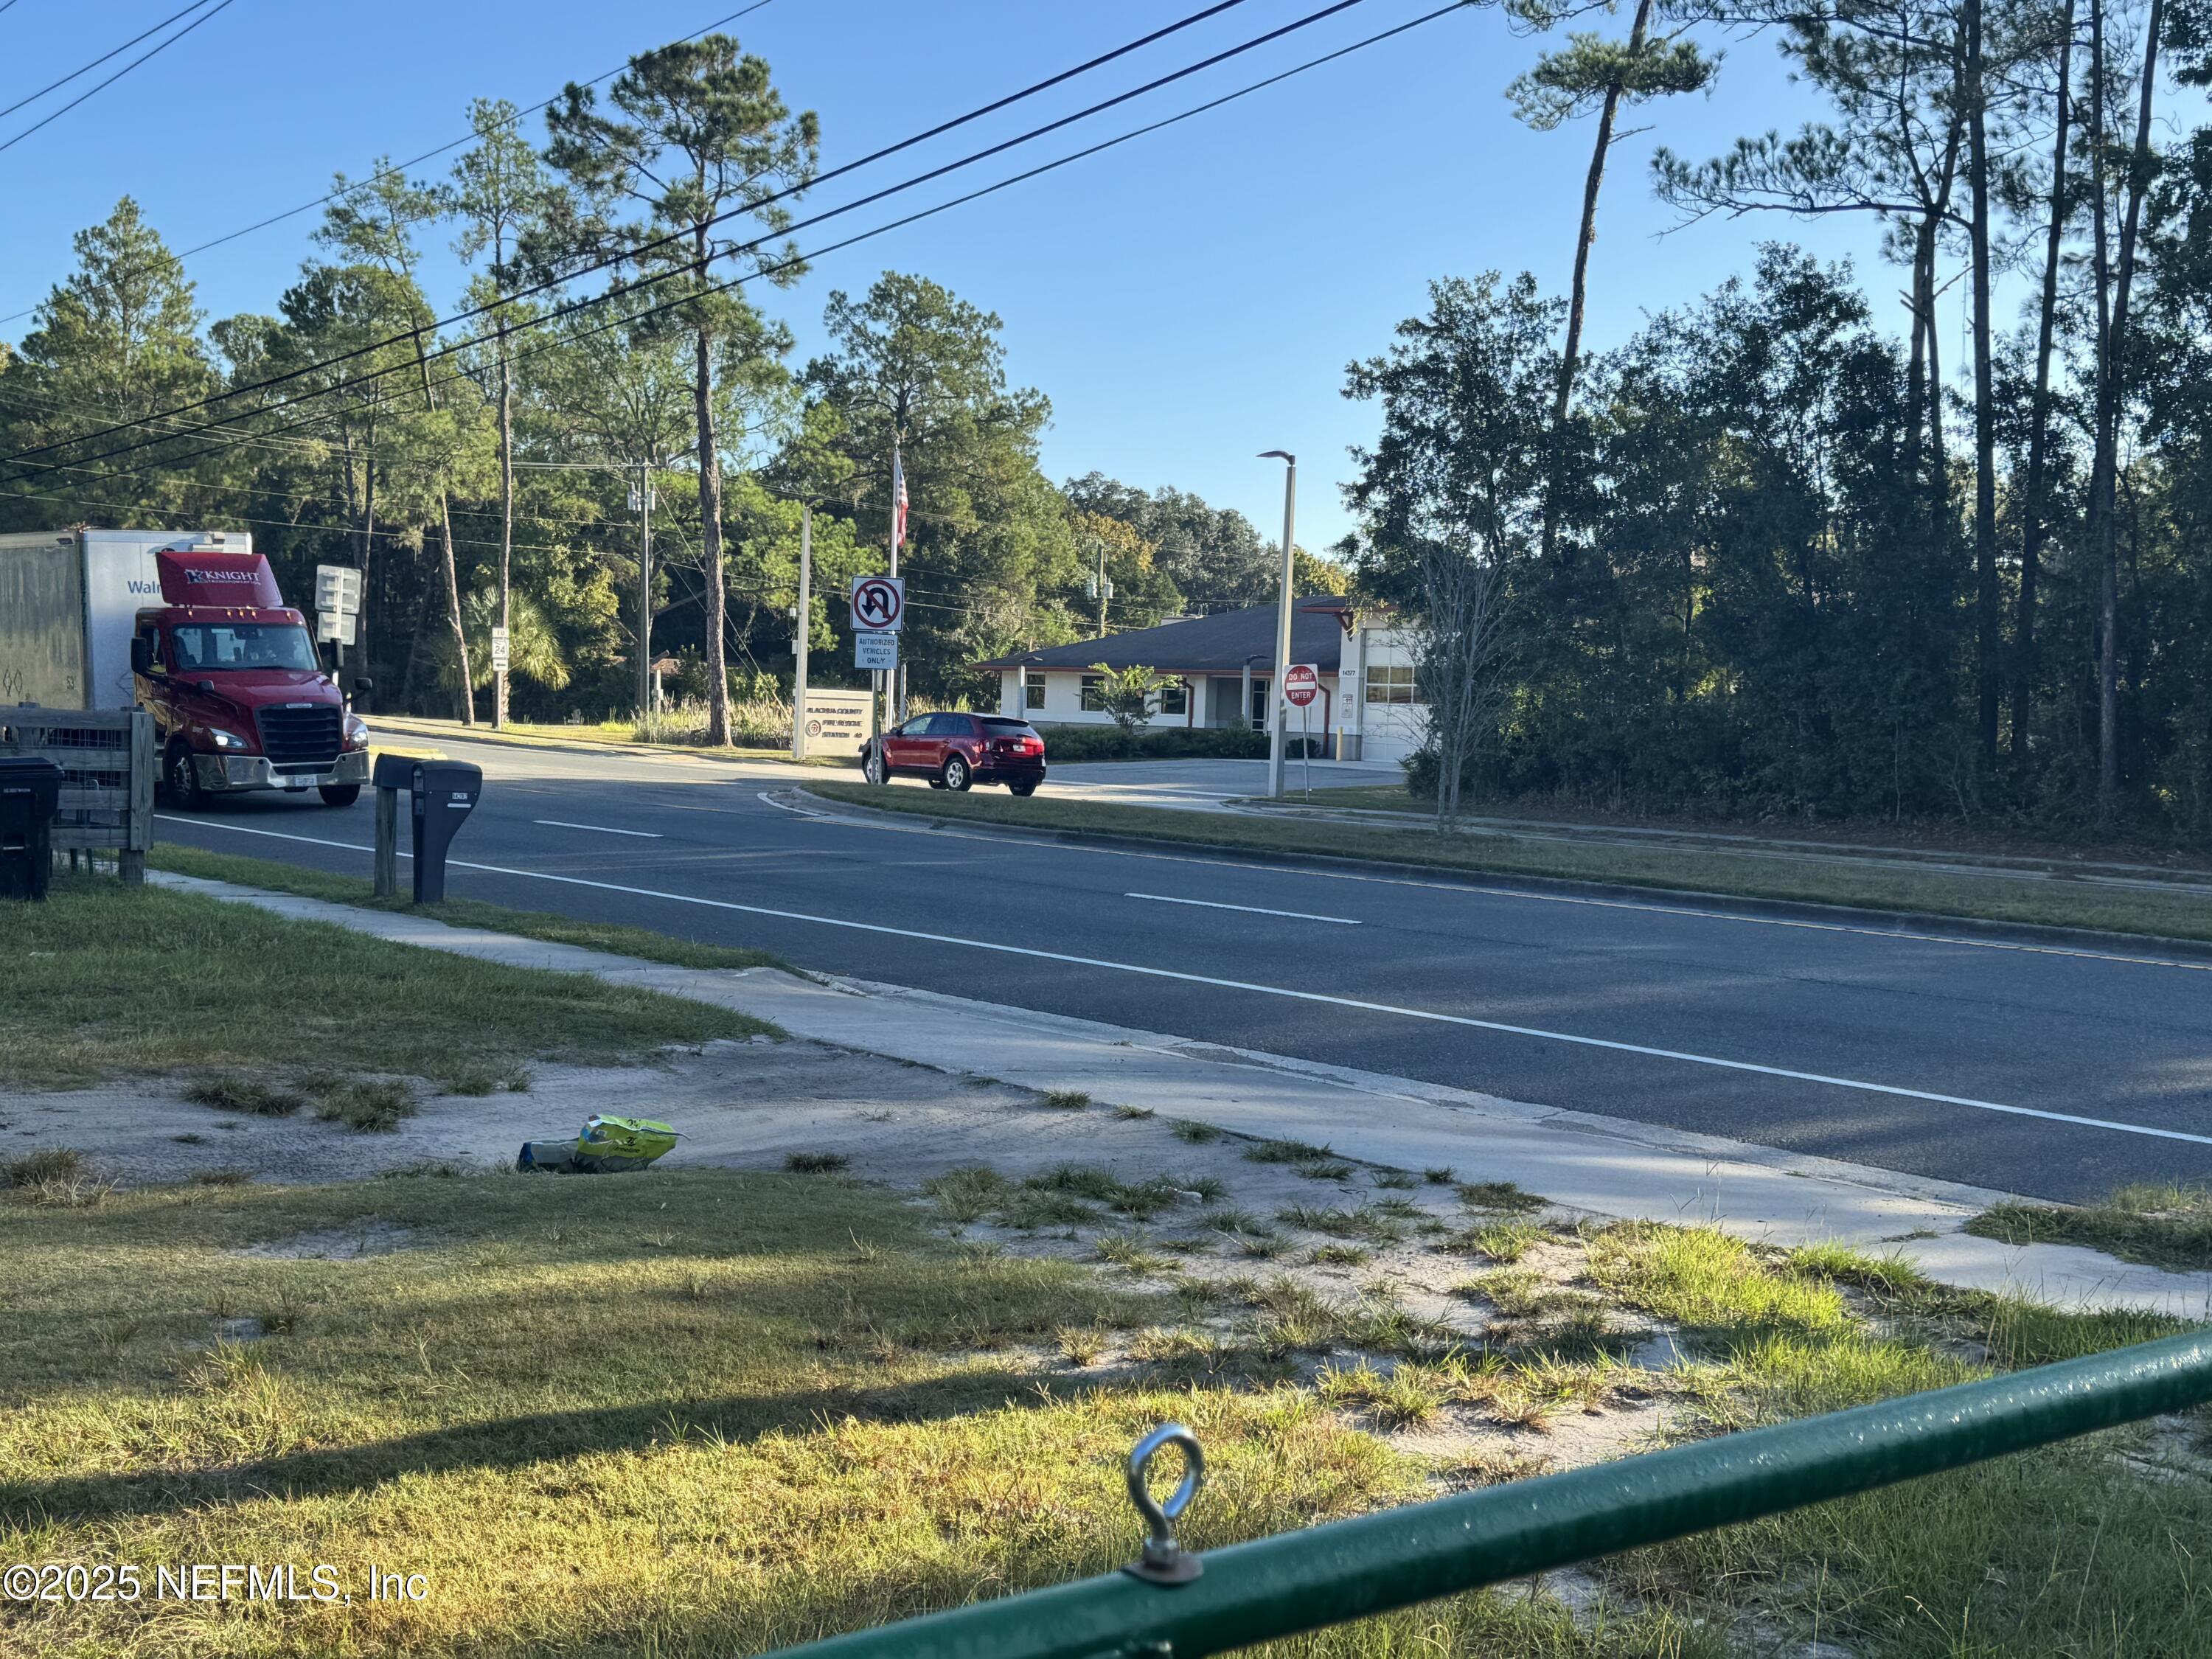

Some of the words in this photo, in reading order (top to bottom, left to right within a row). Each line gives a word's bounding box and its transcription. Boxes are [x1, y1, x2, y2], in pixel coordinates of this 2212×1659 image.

[205, 571, 260, 582] KNIGHT
[859, 638, 894, 646] AUTHORIZED
[495, 645, 505, 655] 24
